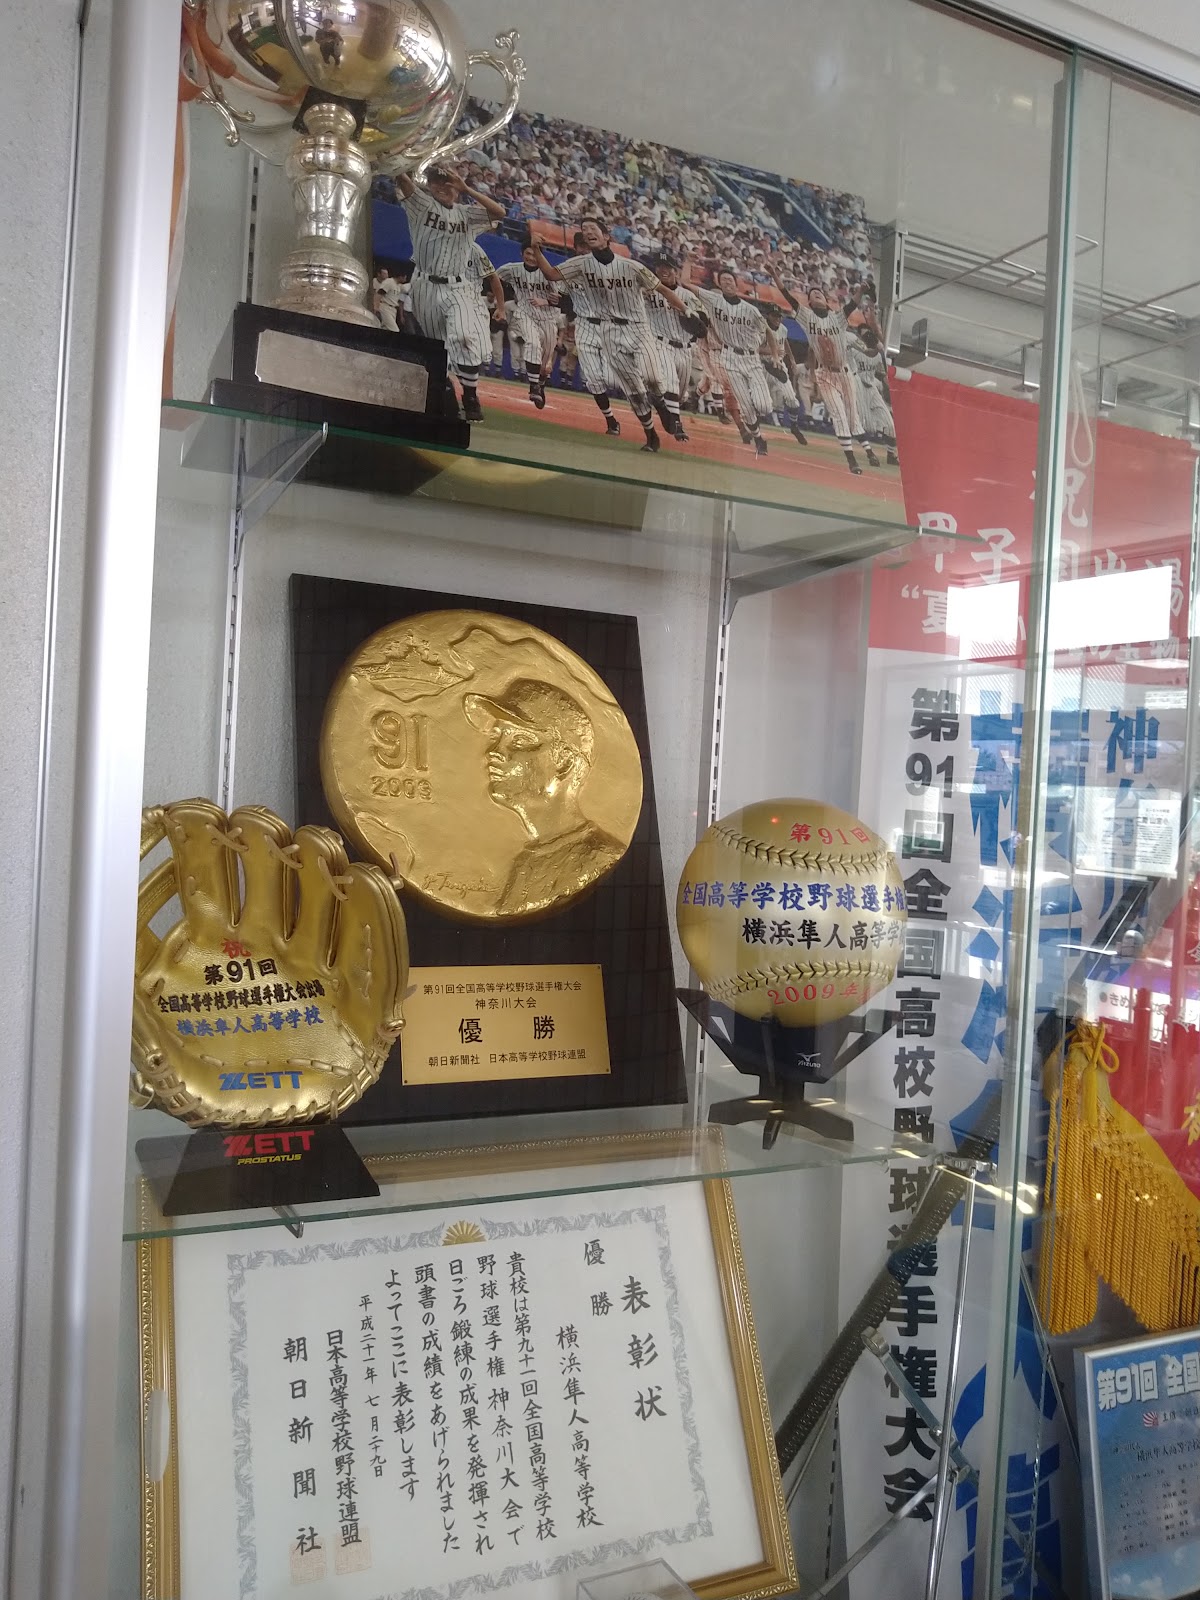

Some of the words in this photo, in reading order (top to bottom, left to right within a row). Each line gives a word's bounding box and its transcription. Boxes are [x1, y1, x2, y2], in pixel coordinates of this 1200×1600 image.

[424, 211, 469, 234] Hayat
[585, 272, 633, 291] Hayato
[714, 307, 751, 327] Hayato
[370, 710, 429, 770] 91
[789, 823, 870, 846] 第91回
[682, 880, 908, 912] 全国高等学校野球選手権
[741, 917, 906, 950] 横浜隼人高等学
[204, 958, 278, 985] 第91回
[423, 981, 582, 995] 第91回全国高等学校野球選手権大会
[475, 996, 537, 1011] 神奈川大会
[176, 1005, 324, 1036] 横浜隼人高等学校
[428, 1053, 480, 1067] 朝日新聞社
[489, 1049, 586, 1064] 日本高等学校野球連盟
[218, 1071, 303, 1091] ZETT
[223, 1130, 315, 1157] ZETT
[237, 1154, 302, 1166] PROSTATUS
[620, 1275, 667, 1421] 表彰状
[384, 1269, 420, 1502] よってここに表彰します
[505, 1251, 557, 1540] 貴校は第九十一回全国高等学校
[1097, 1360, 1160, 1412] 第91回
[414, 1263, 461, 1553] 頭書の成績をあげられました
[449, 1259, 495, 1555] 日ごろ鍛練の成果を発揮され
[326, 1329, 362, 1548] 日本高等学校野球連盟
[555, 1324, 604, 1528] 横浜隼人高等学校
[283, 1337, 322, 1555] 朝日新聞社
